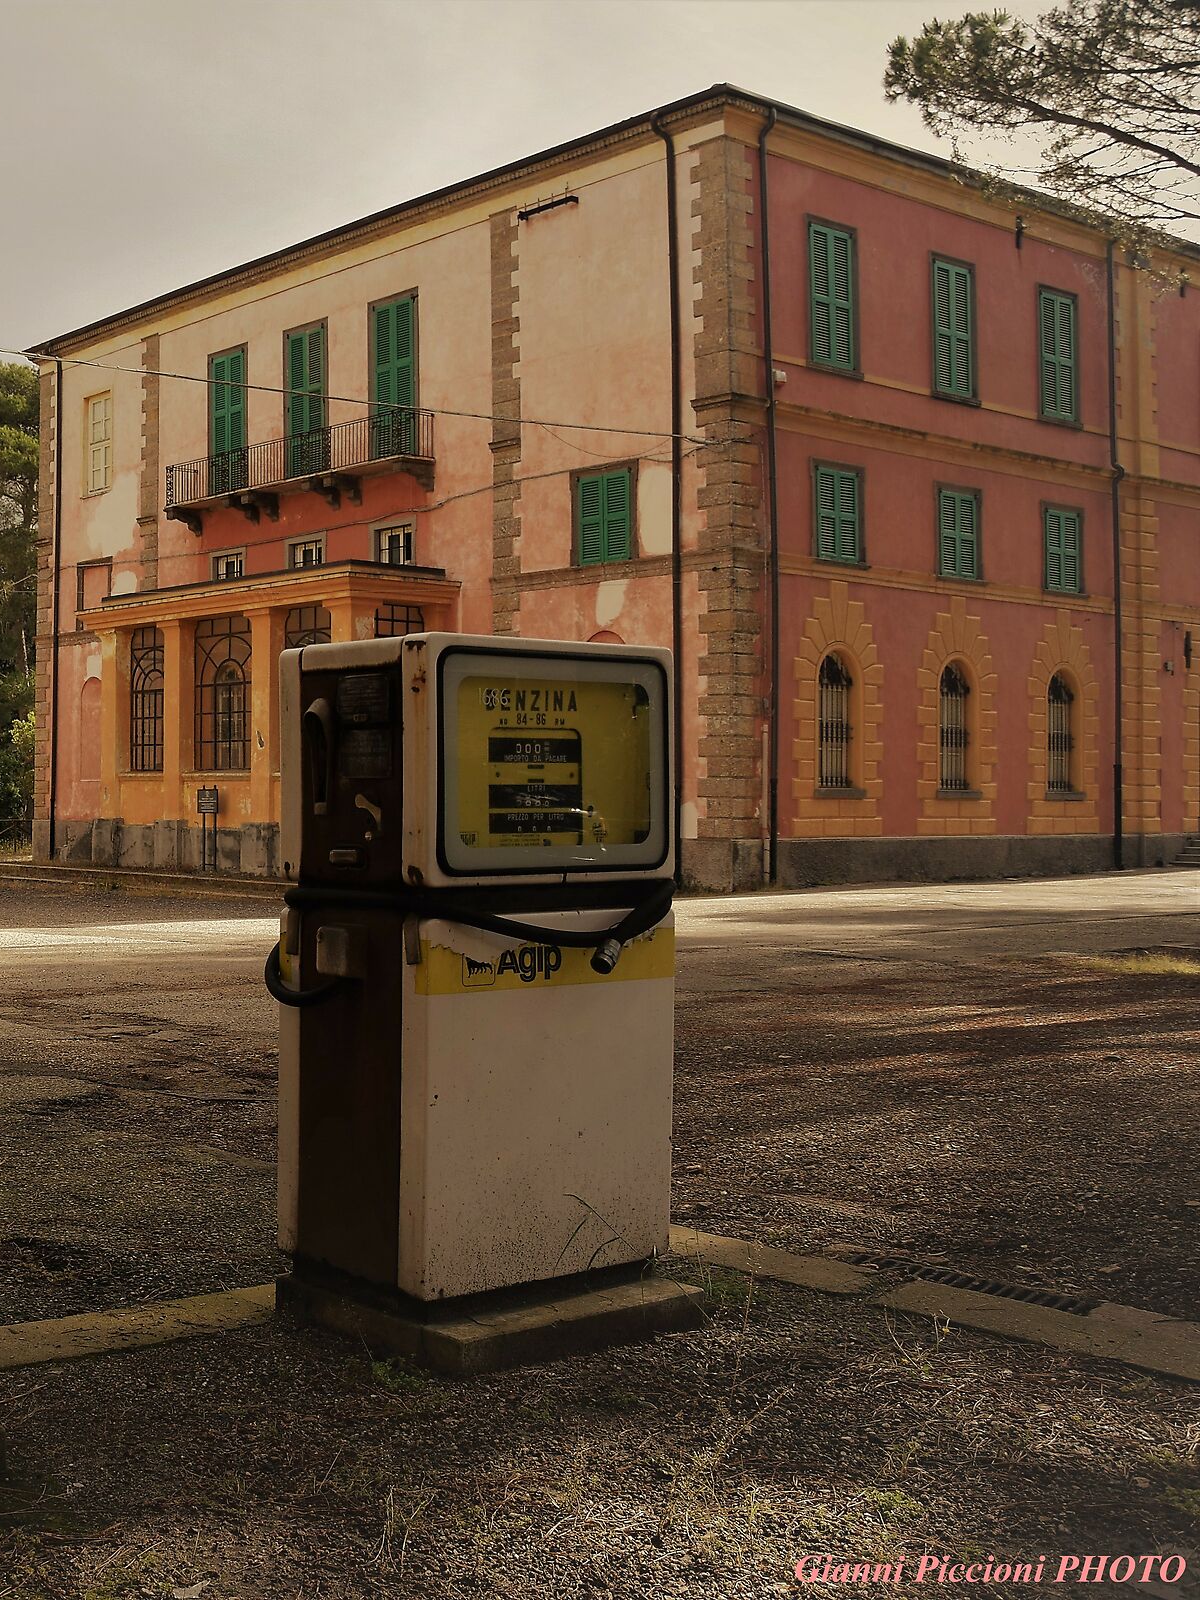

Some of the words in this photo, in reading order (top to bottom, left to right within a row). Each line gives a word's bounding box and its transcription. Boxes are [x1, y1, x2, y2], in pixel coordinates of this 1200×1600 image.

[504, 754, 529, 762] IMPORTO
[545, 755, 567, 763] PAGARE
[496, 944, 562, 982] Agip
